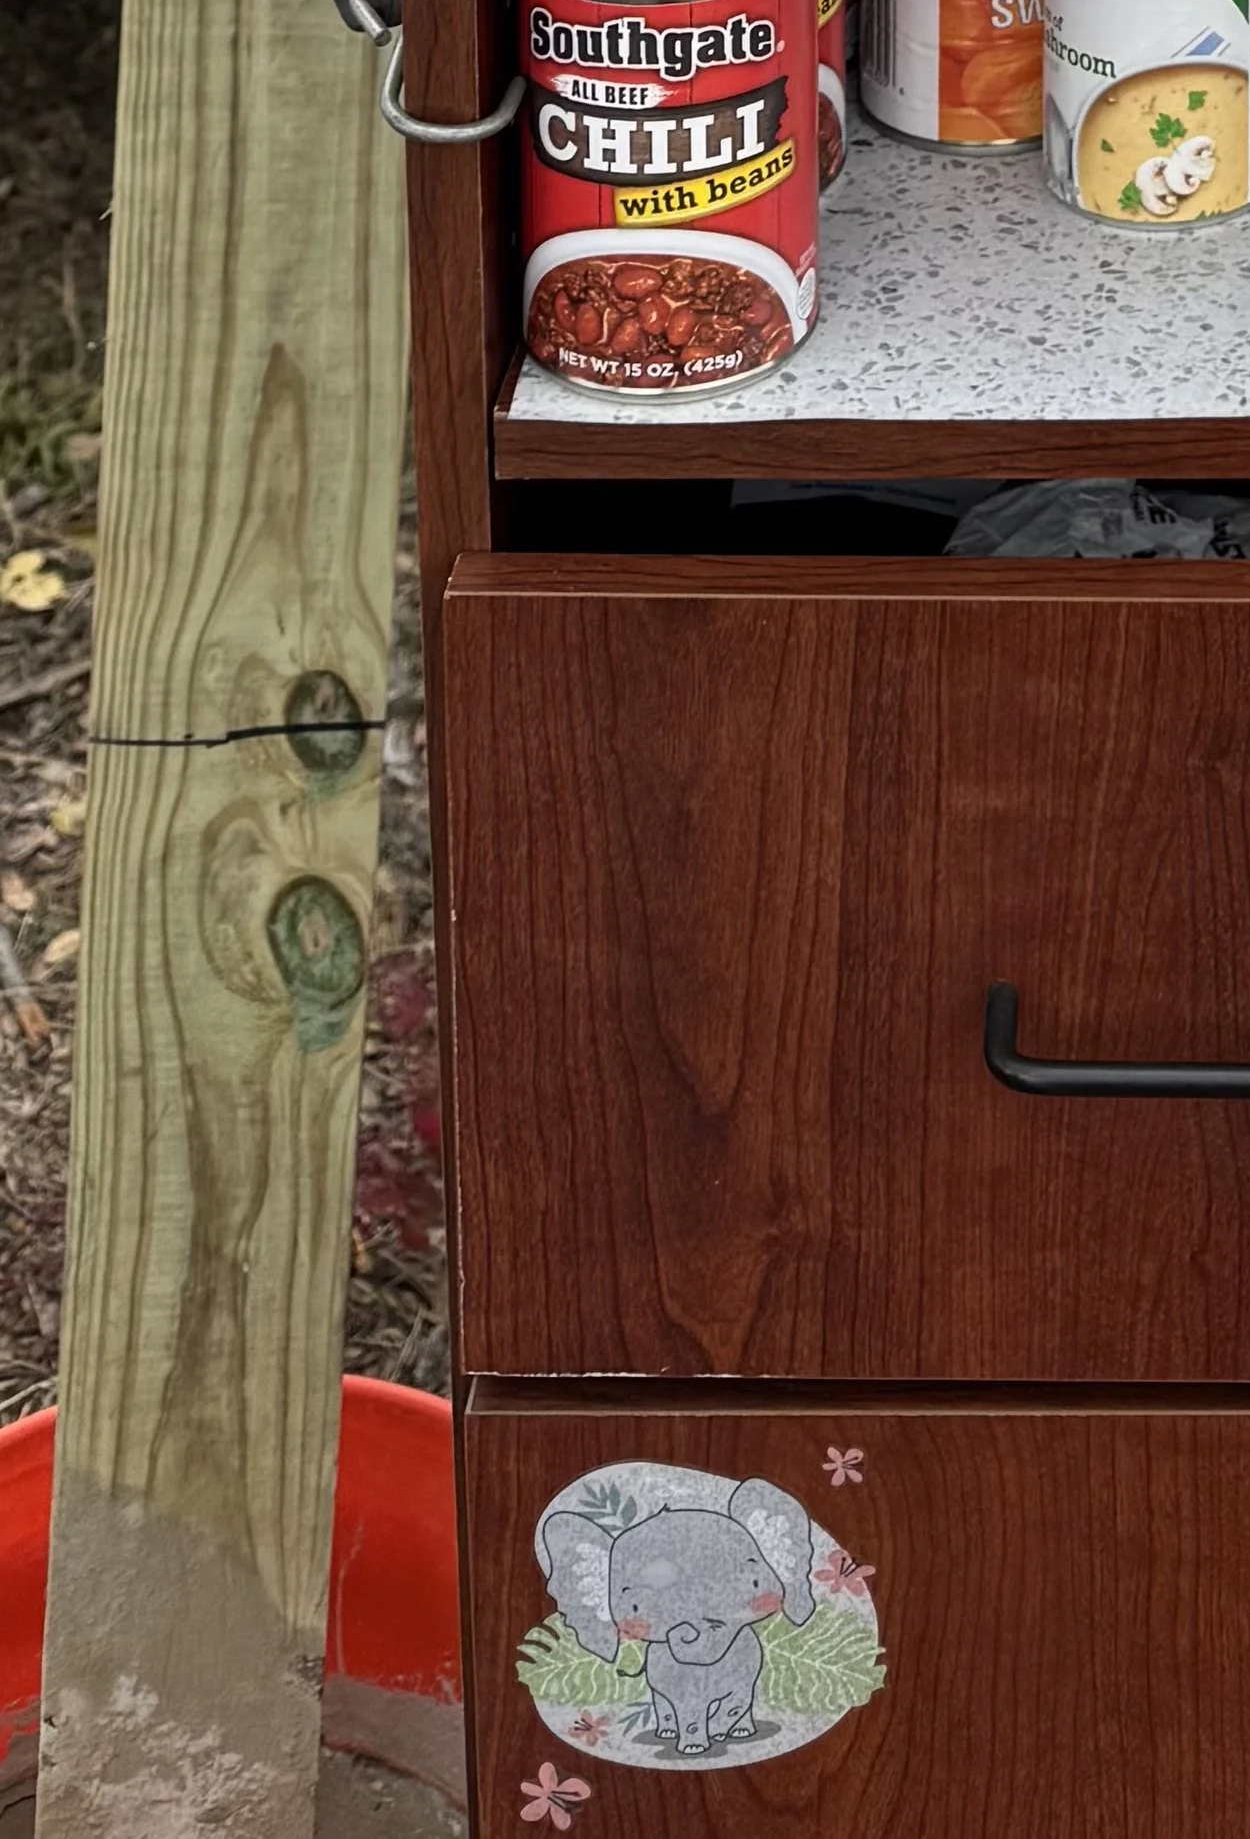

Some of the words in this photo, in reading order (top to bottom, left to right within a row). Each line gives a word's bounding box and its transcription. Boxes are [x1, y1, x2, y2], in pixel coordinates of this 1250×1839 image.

[530, 6, 775, 82] Southgate
[571, 79, 599, 103] ALL
[604, 84, 650, 106] BEEF
[538, 100, 765, 175] CHILI
[620, 186, 698, 217] with
[708, 147, 794, 204] beans
[558, 347, 589, 369] NET
[590, 357, 619, 376] WT
[623, 362, 642, 377] 15
